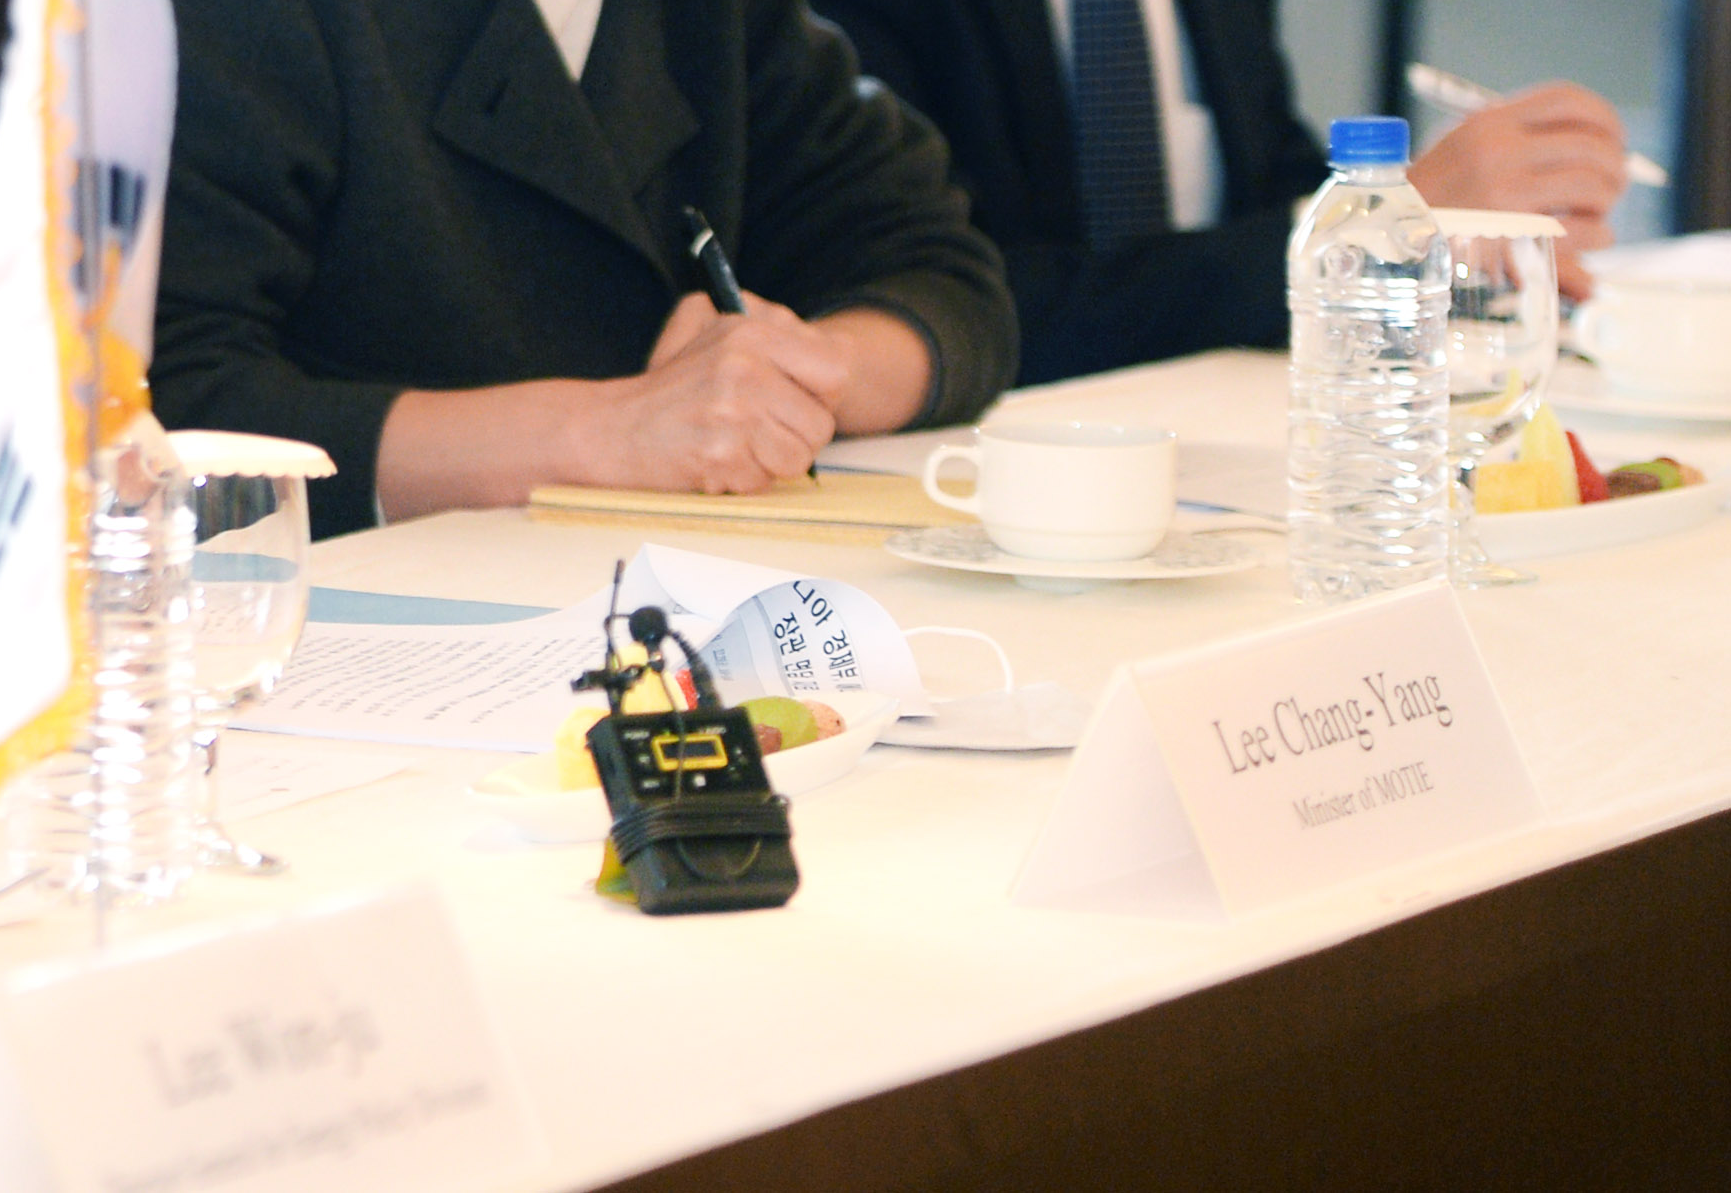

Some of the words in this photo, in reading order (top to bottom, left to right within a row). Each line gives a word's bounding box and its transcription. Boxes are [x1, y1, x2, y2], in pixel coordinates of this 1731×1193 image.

[774, 612, 807, 656] 장관
[1212, 720, 1275, 774] Lee
[1273, 672, 1453, 755] Chang-Yang
[1292, 791, 1356, 830] Minister
[1359, 777, 1379, 810] of
[1372, 761, 1434, 805] MOTIE
